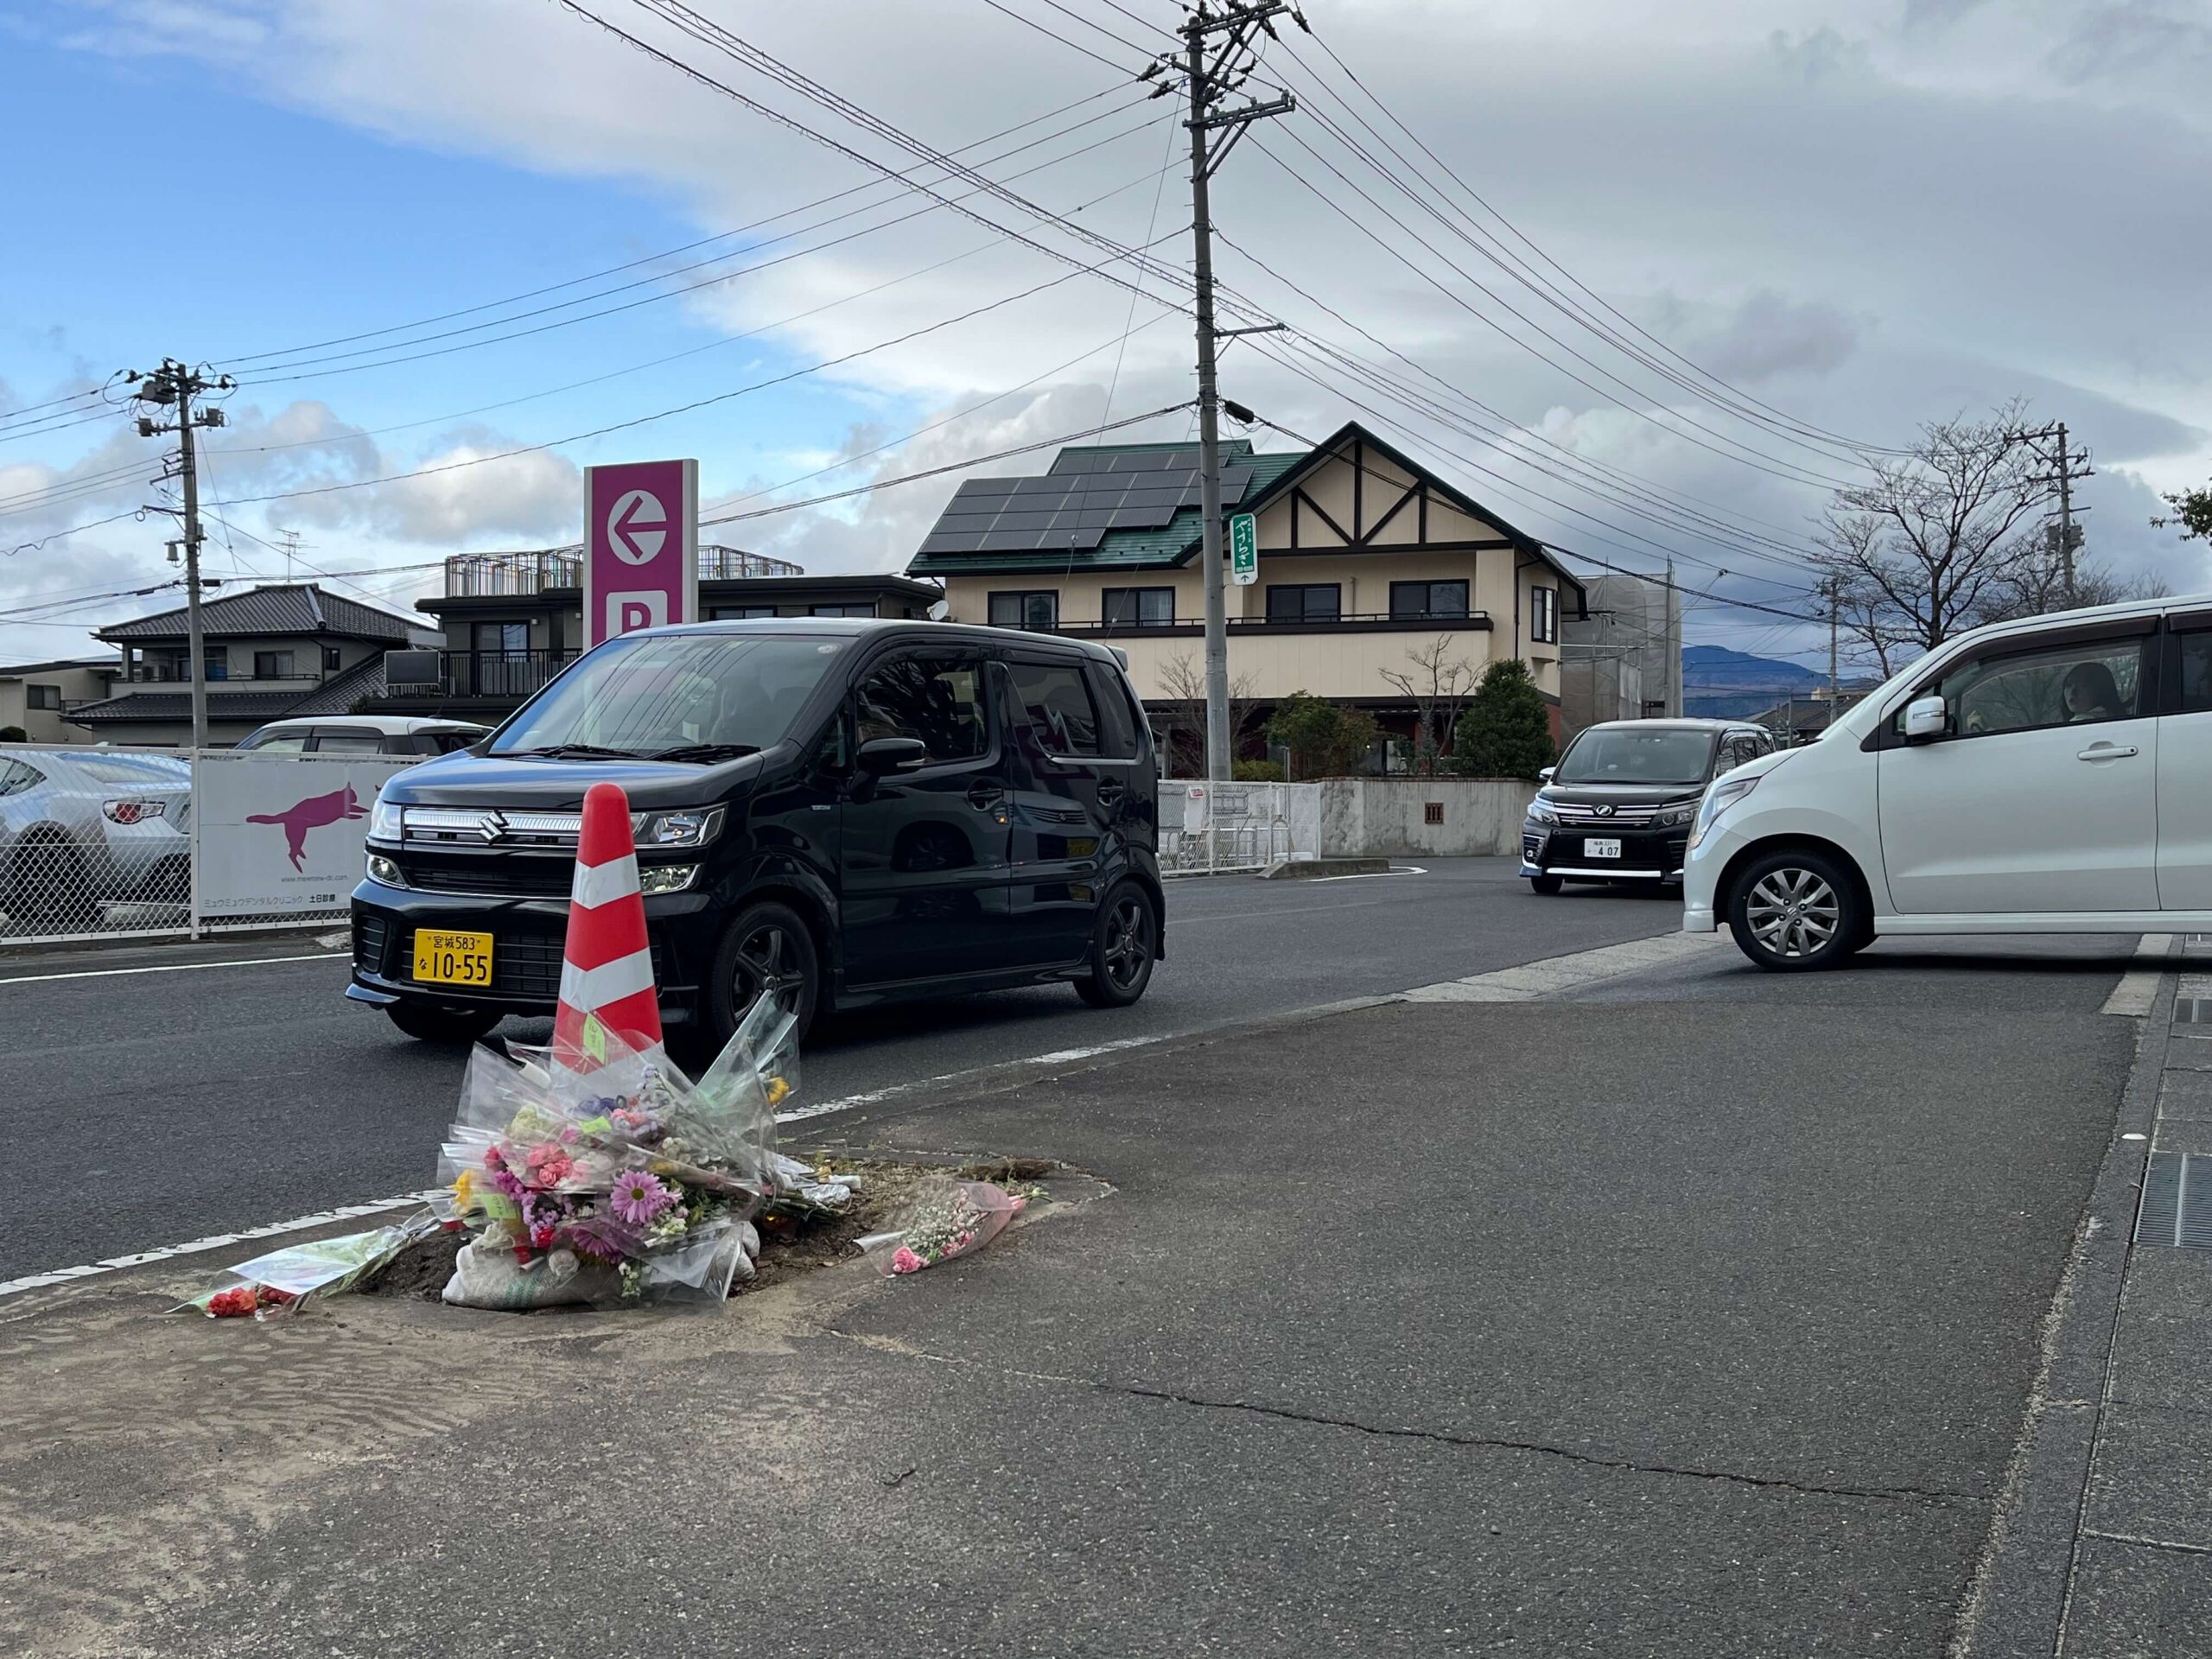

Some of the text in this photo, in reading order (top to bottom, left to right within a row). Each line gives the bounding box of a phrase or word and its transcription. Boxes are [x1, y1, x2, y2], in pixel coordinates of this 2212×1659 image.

[308, 893, 336, 904] 土日診療
[434, 951, 488, 982] 10-55
